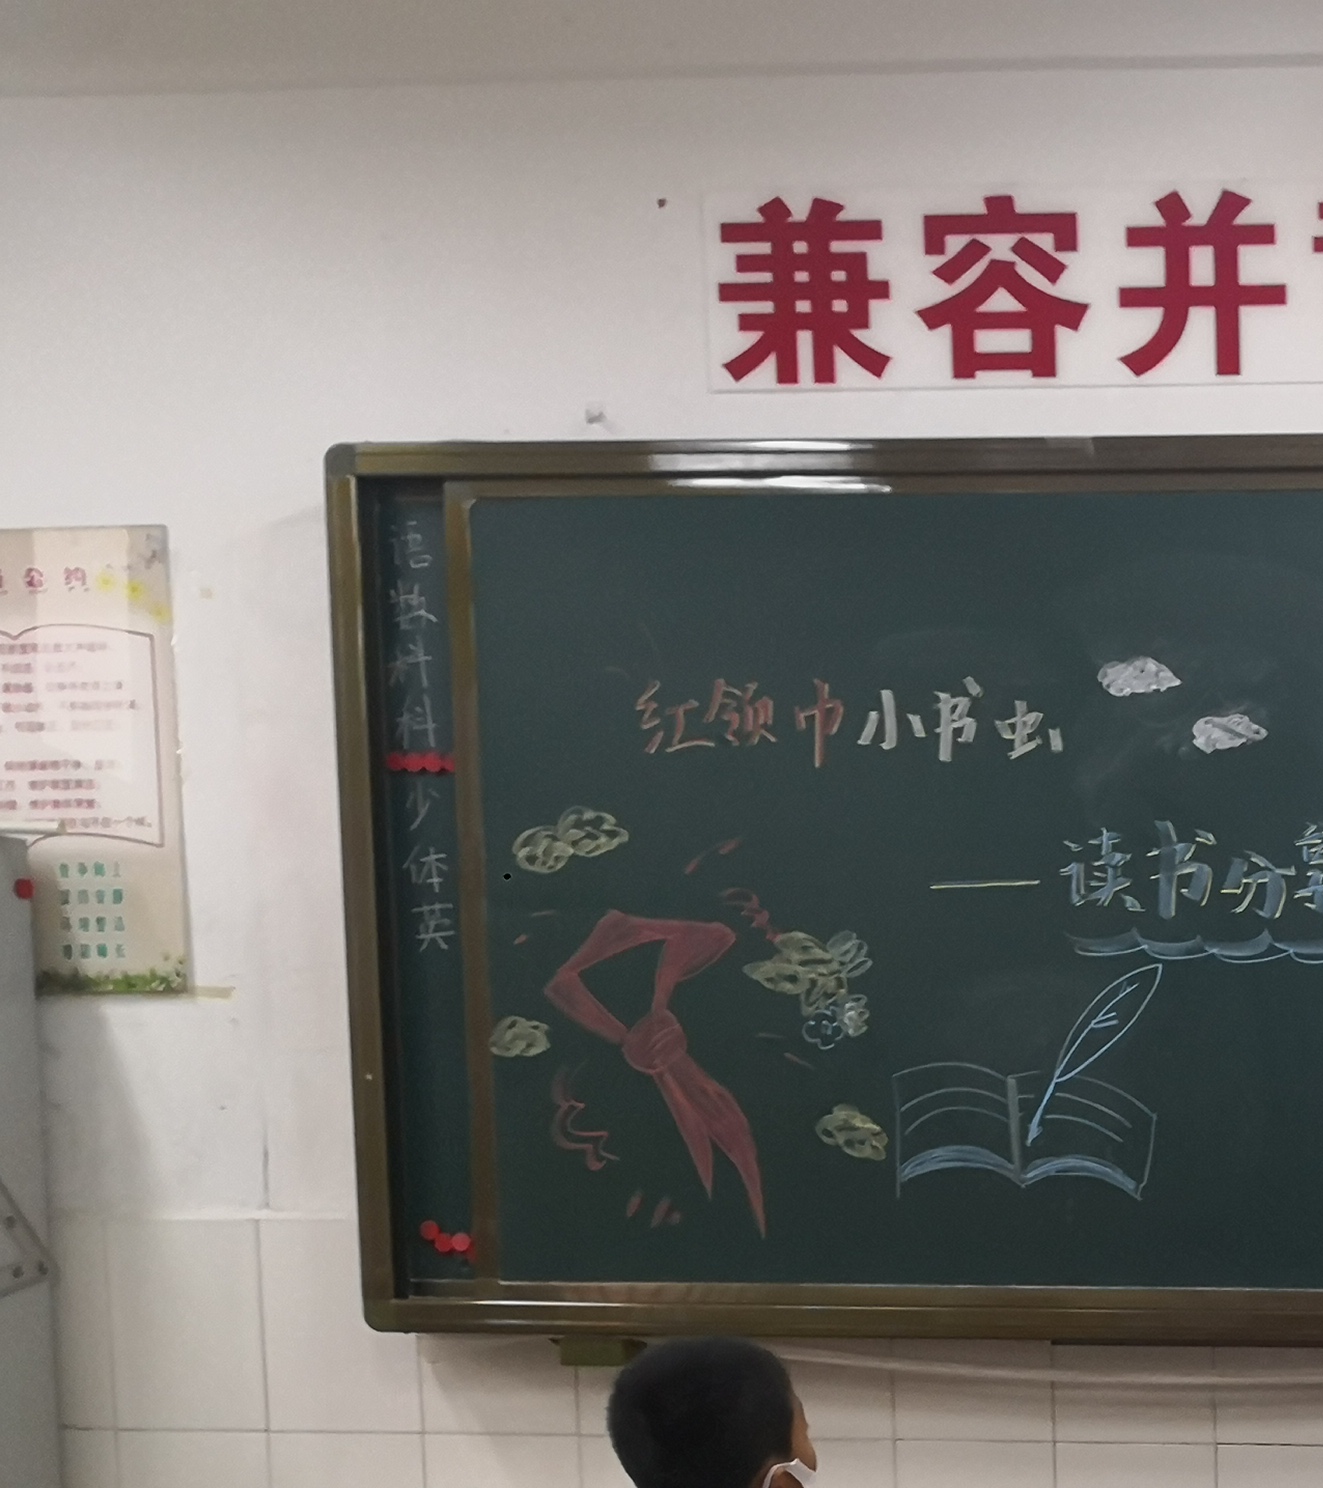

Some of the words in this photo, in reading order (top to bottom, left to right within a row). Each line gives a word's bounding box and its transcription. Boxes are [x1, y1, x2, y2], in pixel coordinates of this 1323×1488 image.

[635, 676, 1064, 768] 红领巾小书虫
